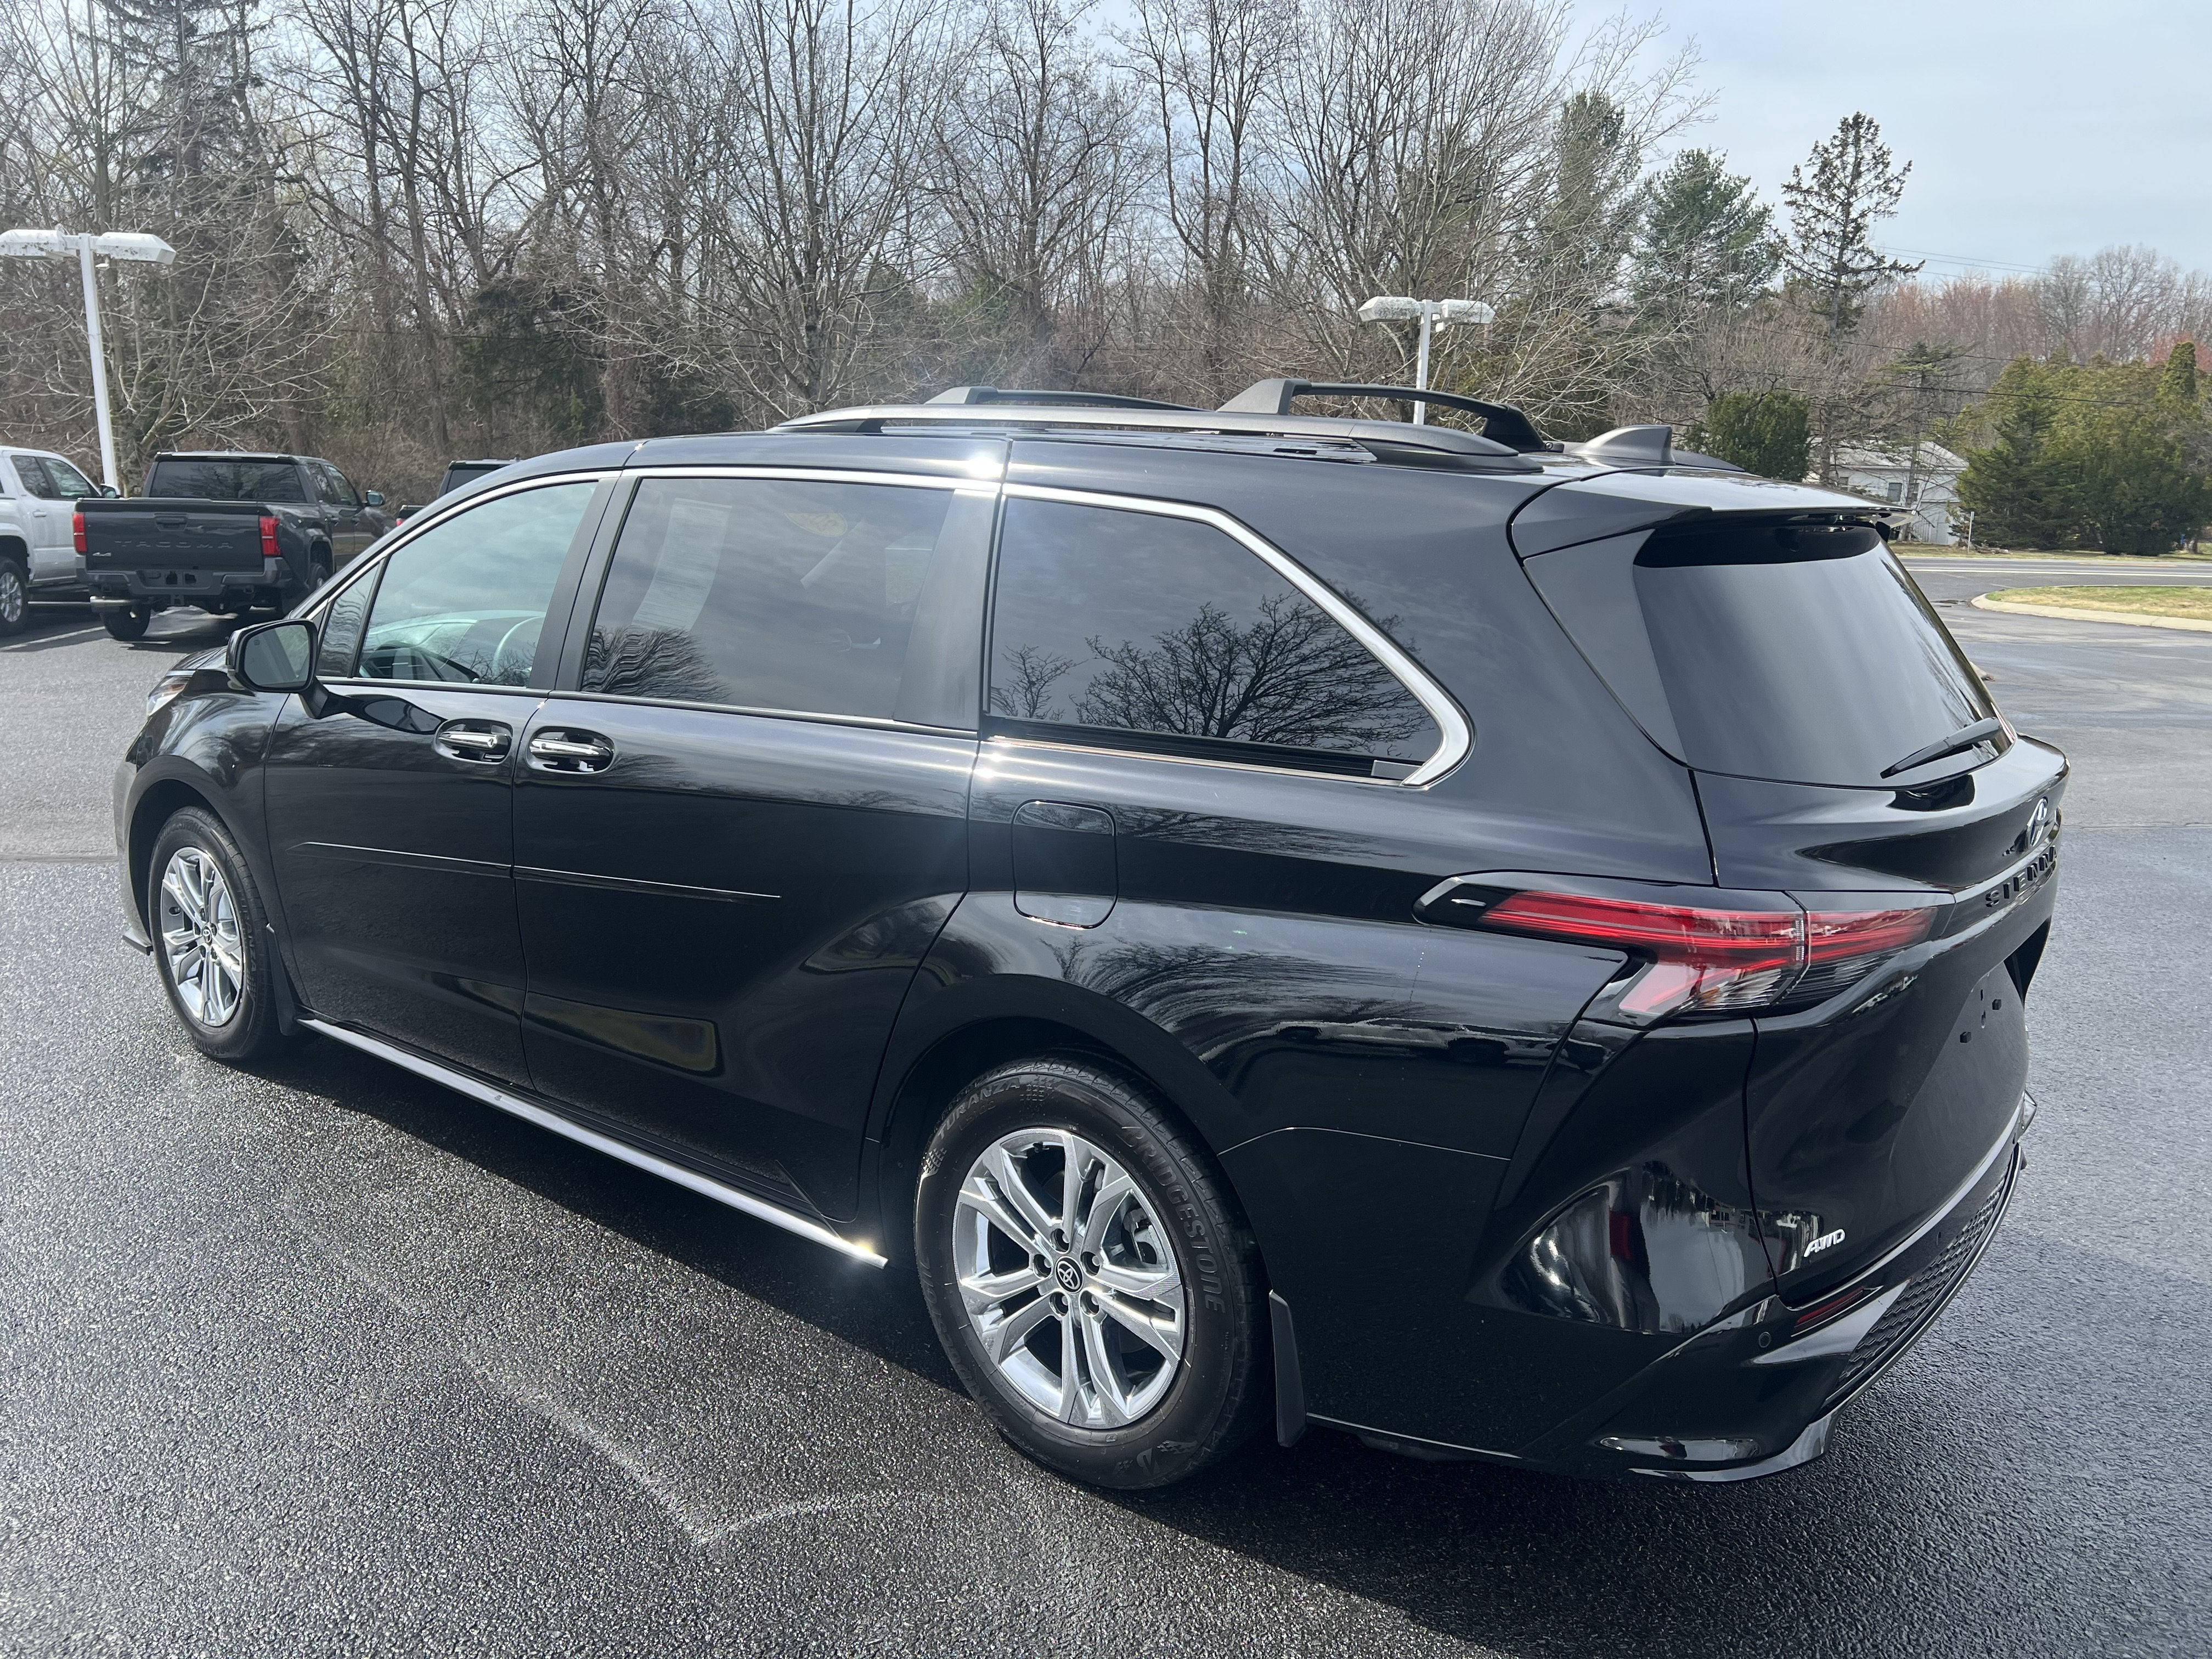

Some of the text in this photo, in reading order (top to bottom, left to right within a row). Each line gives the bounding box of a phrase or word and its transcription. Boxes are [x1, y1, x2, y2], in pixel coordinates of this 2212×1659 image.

[114, 540, 234, 549] TACOMA
[937, 1077, 1020, 1139] TURANZA
[1116, 1126, 1226, 1314] BRIDGESTONE
[1803, 1228, 1846, 1257] AWD
